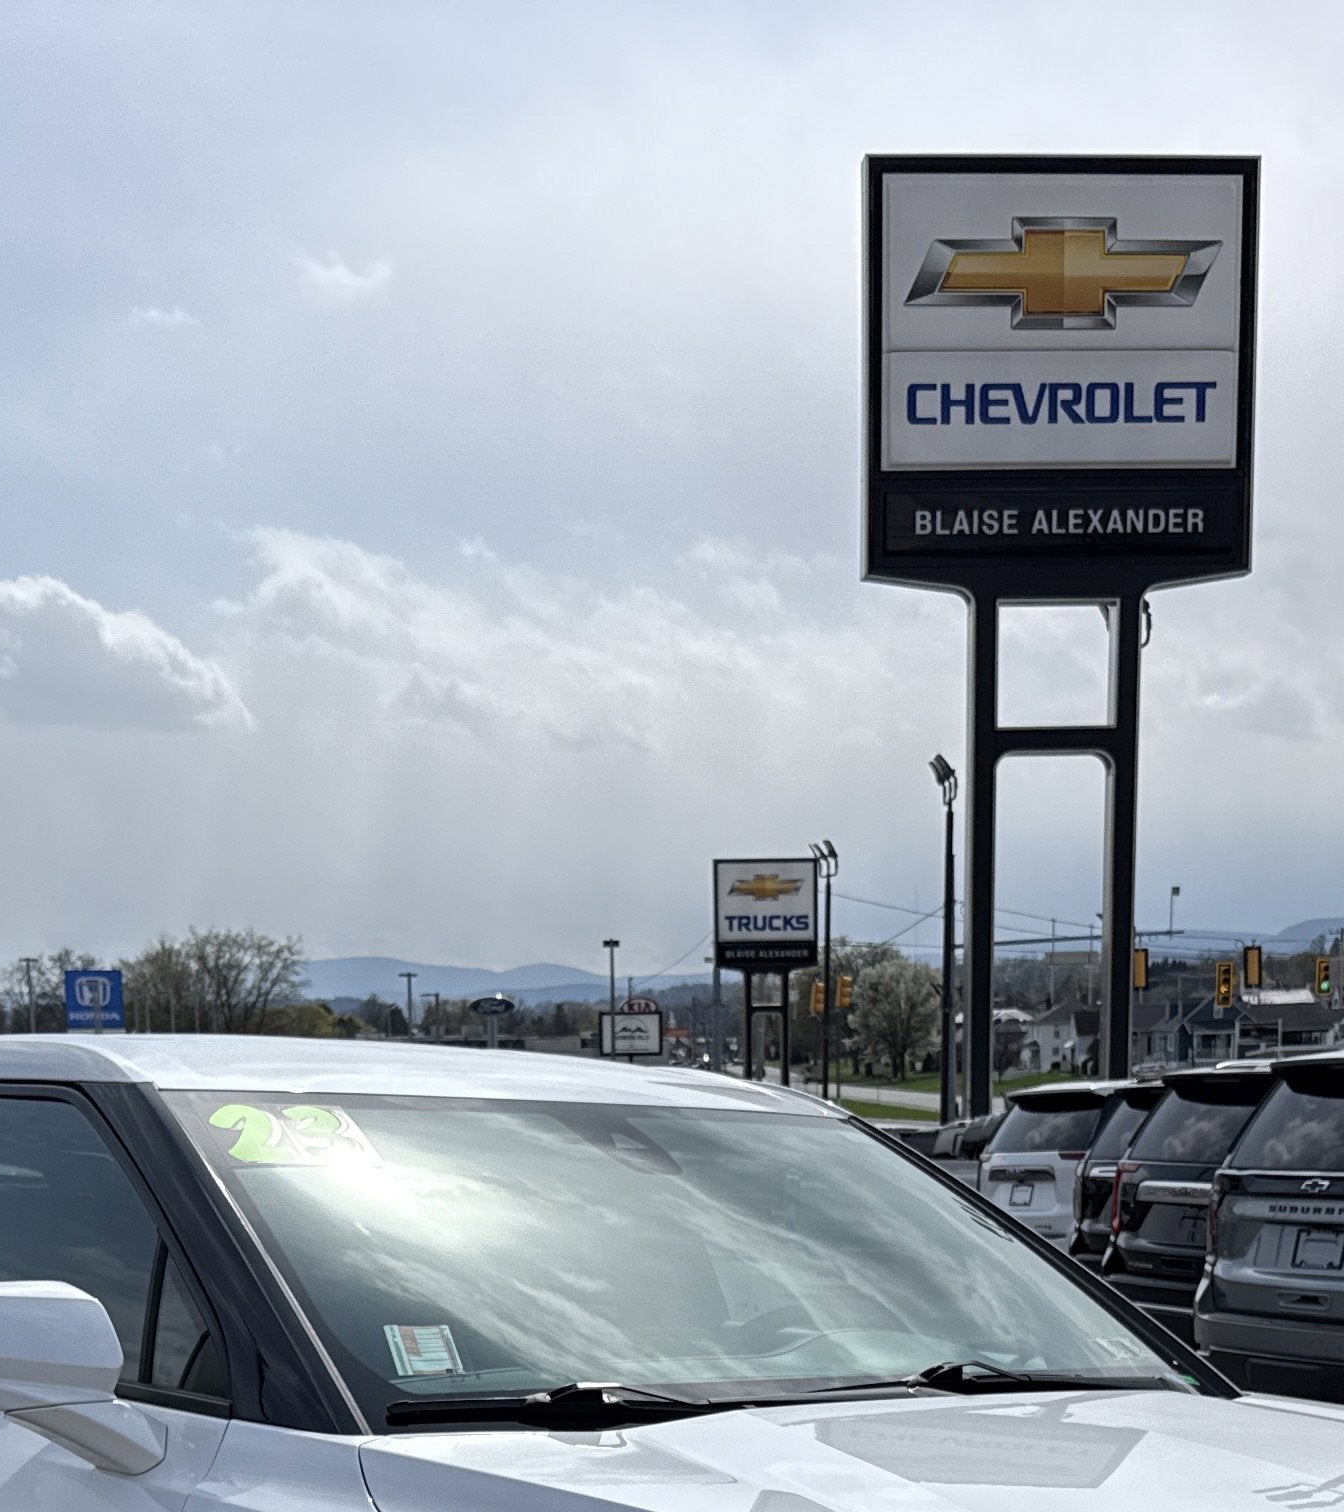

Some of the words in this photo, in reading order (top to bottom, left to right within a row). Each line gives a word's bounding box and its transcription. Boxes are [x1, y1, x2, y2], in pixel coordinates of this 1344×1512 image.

[907, 381, 1217, 425] CHEVROLET
[914, 509, 1019, 536] BLAISE
[1031, 508, 1205, 535] ALEXANDER
[724, 914, 810, 932] TRUCKS
